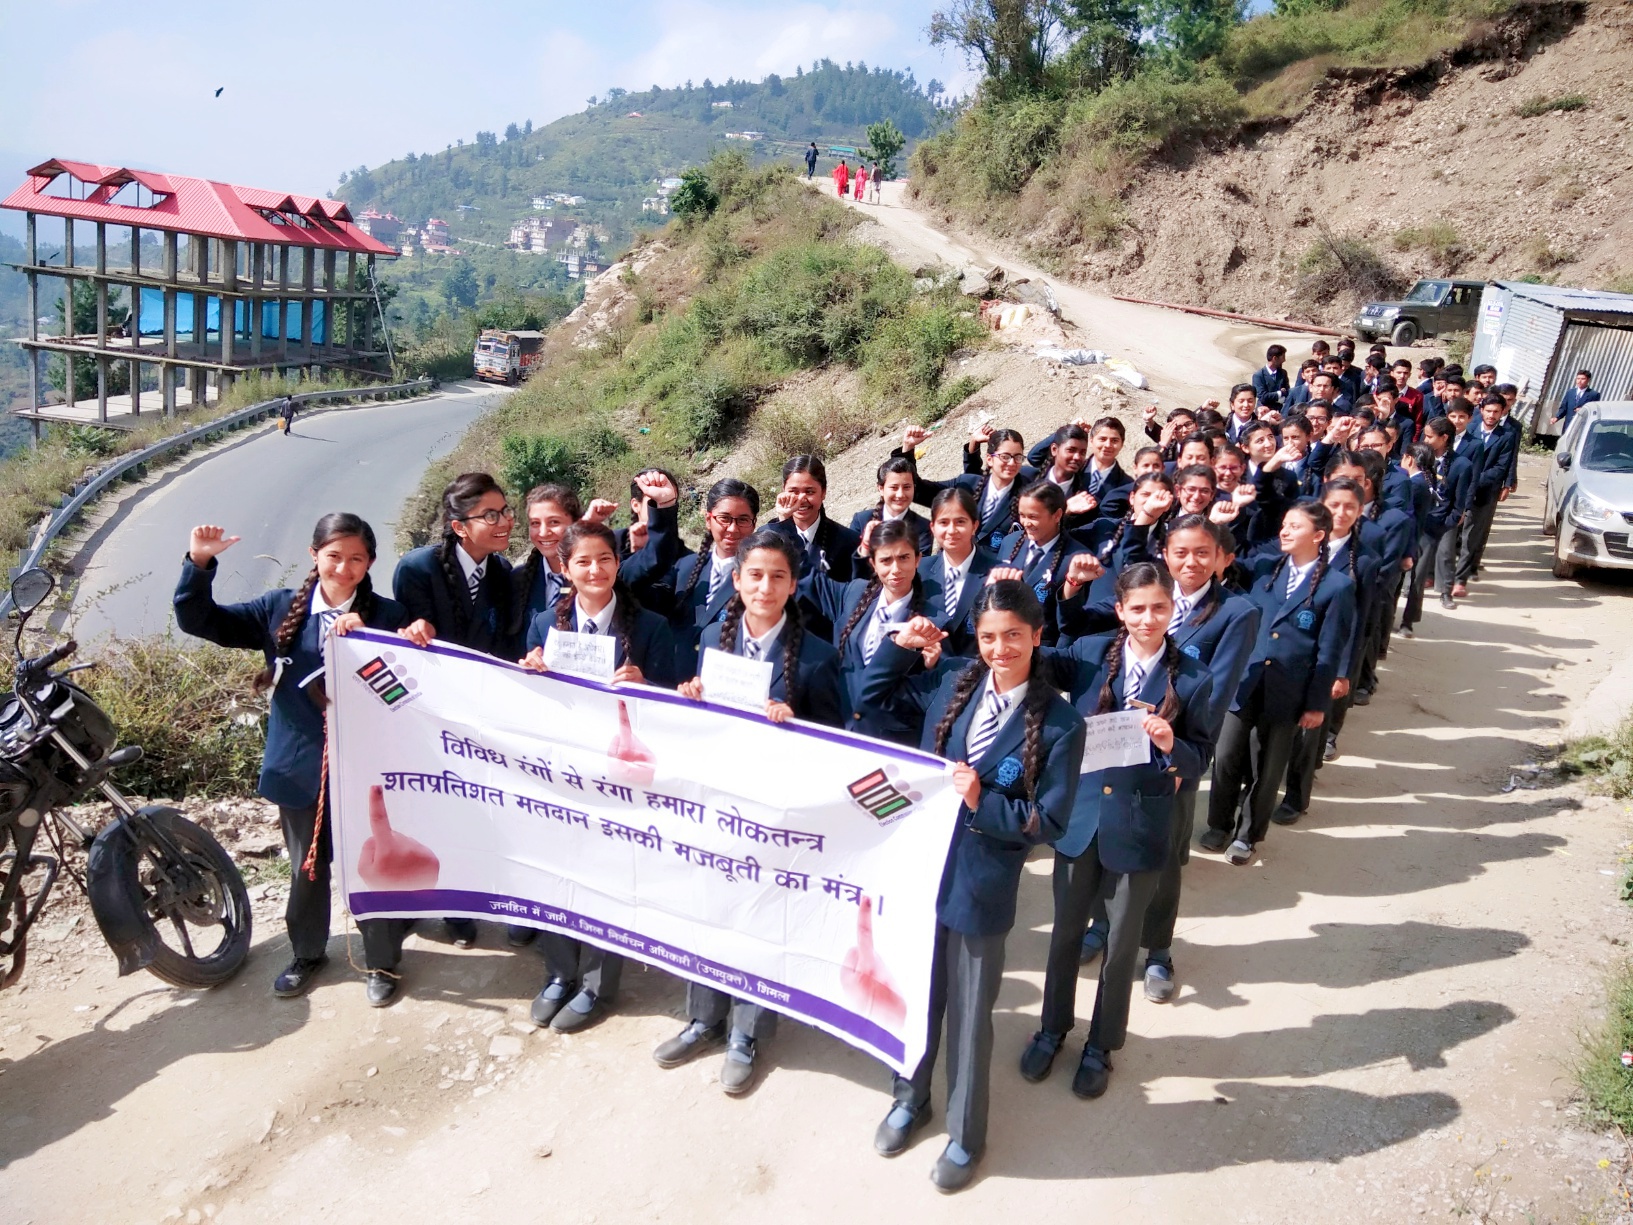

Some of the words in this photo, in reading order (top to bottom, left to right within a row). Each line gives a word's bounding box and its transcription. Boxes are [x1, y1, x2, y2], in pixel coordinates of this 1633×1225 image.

[381, 770, 505, 807] शतप्रतिशत
[513, 793, 590, 830] मतदान
[599, 817, 662, 852] इसकी
[672, 840, 761, 883] मजबूती
[774, 867, 810, 892] का
[822, 874, 864, 906] मंत्र
[440, 730, 508, 768] विविध
[513, 755, 553, 783] रंगों
[561, 765, 584, 791] से
[592, 776, 634, 803] रंगा
[643, 790, 705, 824] हमारा
[715, 805, 825, 853] लोकतन्त्र
[489, 900, 528, 915] जनहित
[531, 905, 541, 917] में
[544, 909, 568, 925] जारी
[578, 919, 604, 936] जिला
[607, 928, 645, 951] निर्वाचन
[648, 944, 691, 968] अधिकारी
[756, 981, 791, 1003] शिमला
